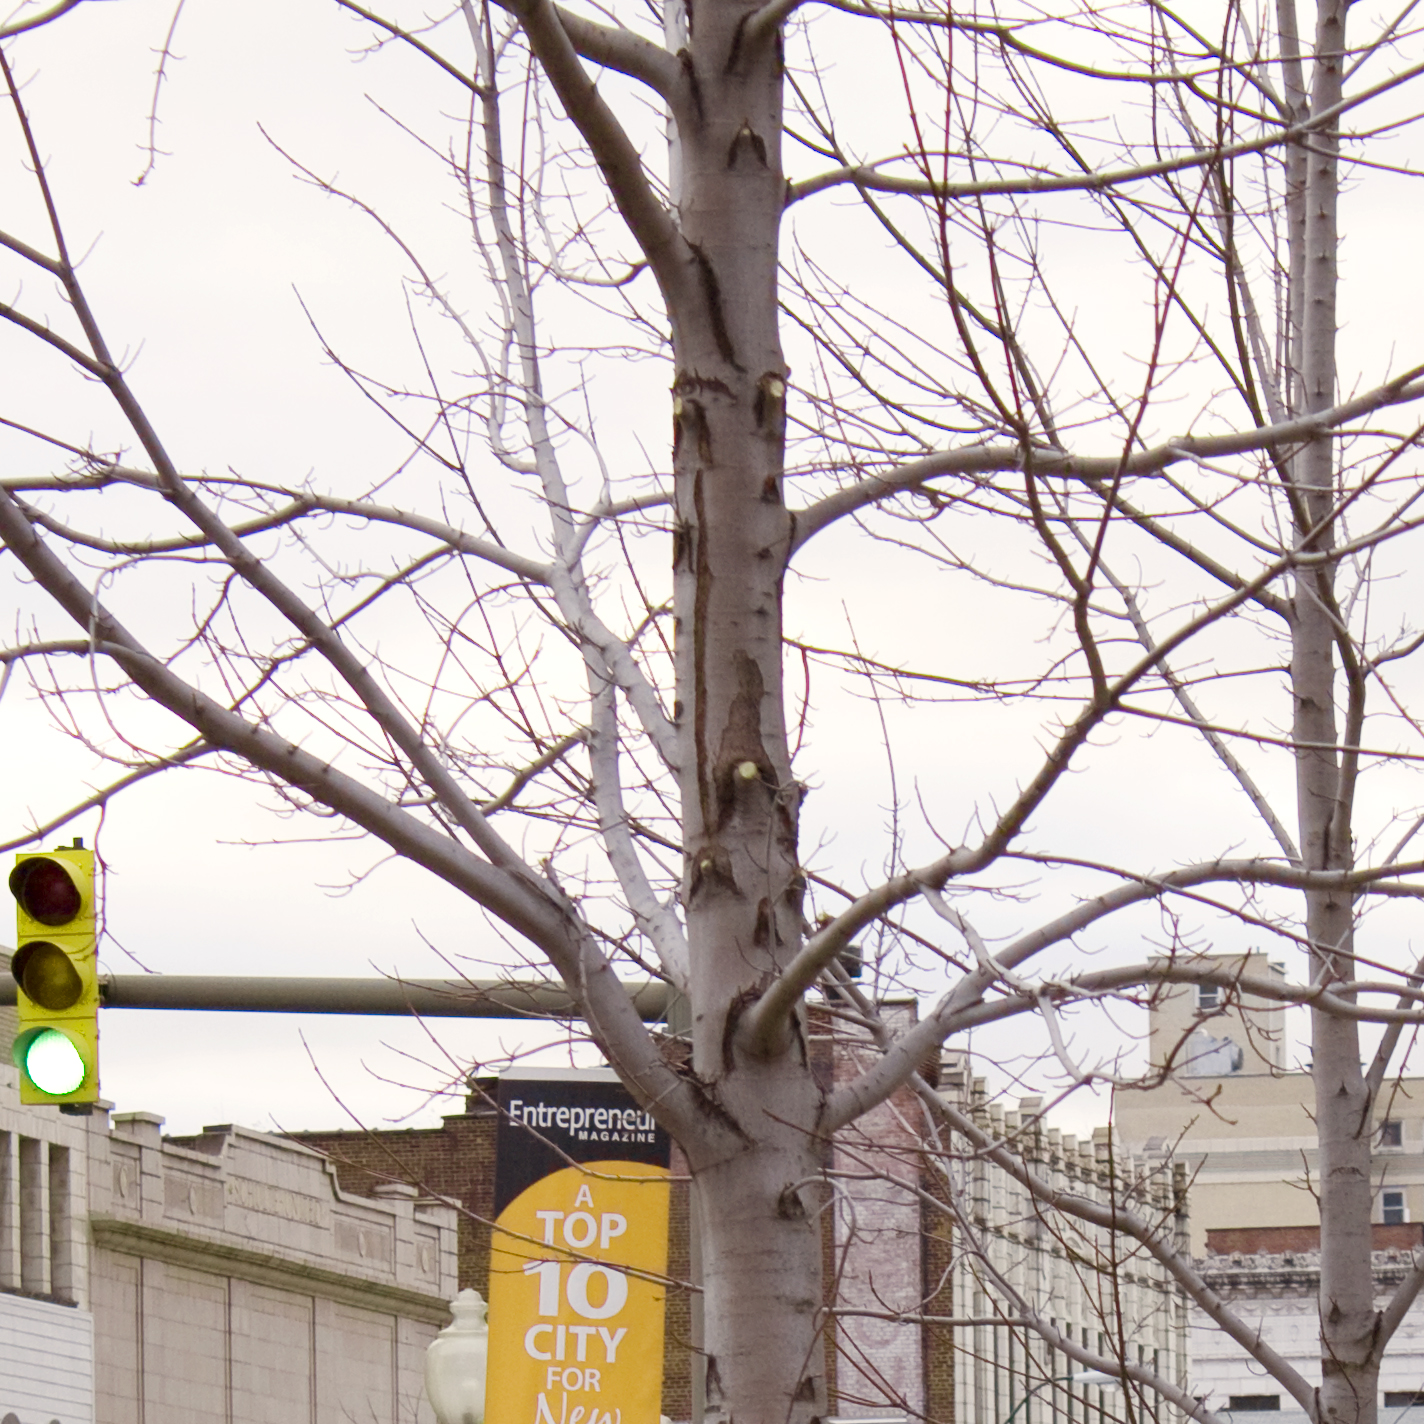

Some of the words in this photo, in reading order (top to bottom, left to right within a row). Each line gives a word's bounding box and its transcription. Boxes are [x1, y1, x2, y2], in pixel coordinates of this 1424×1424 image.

[579, 1131, 656, 1143] MAGAZINE
[574, 1184, 594, 1208] A
[536, 1210, 627, 1249] TOP
[523, 1260, 628, 1320] 10
[524, 1324, 628, 1363] CITY
[546, 1366, 601, 1392] FOR
